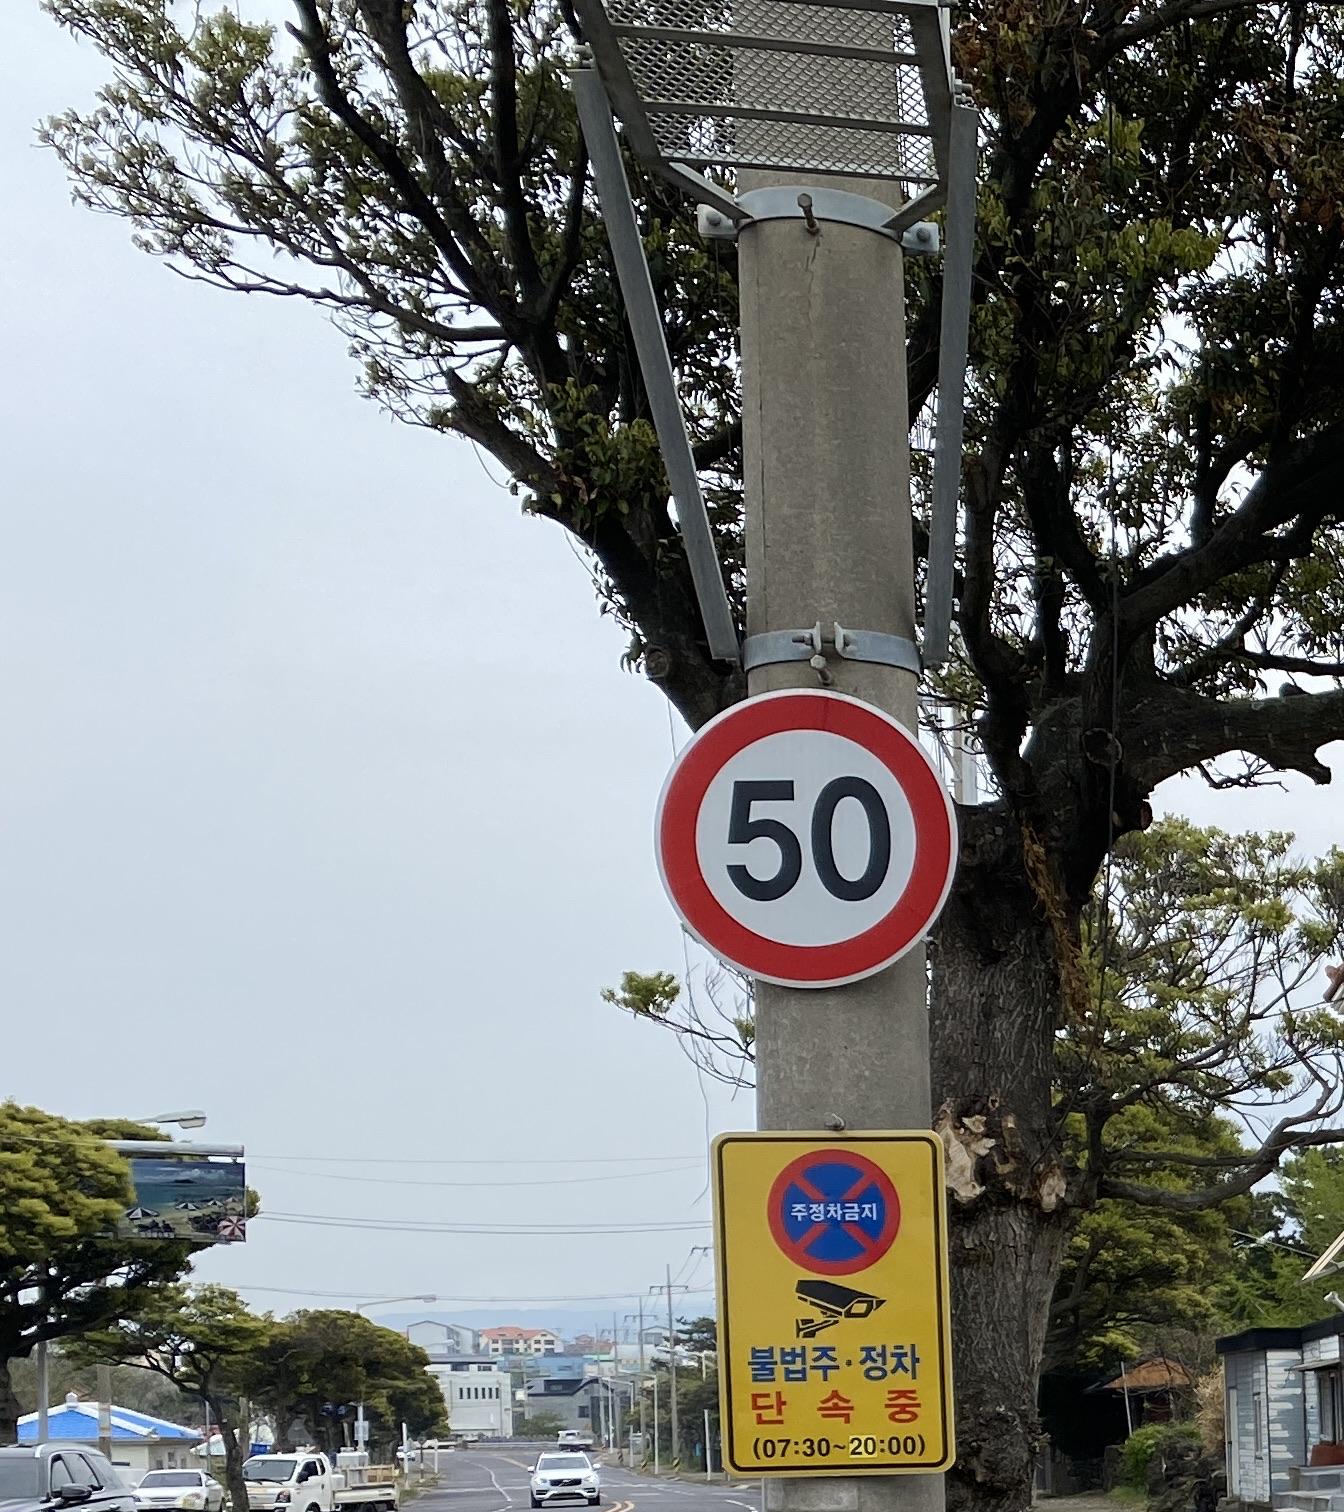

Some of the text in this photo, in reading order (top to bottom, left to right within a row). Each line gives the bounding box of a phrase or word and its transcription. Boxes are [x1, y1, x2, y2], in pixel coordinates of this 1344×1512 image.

[726, 776, 891, 902] 50
[790, 1203, 877, 1222] 주정차금지
[753, 1434, 926, 1459] (07:30~20:00)
